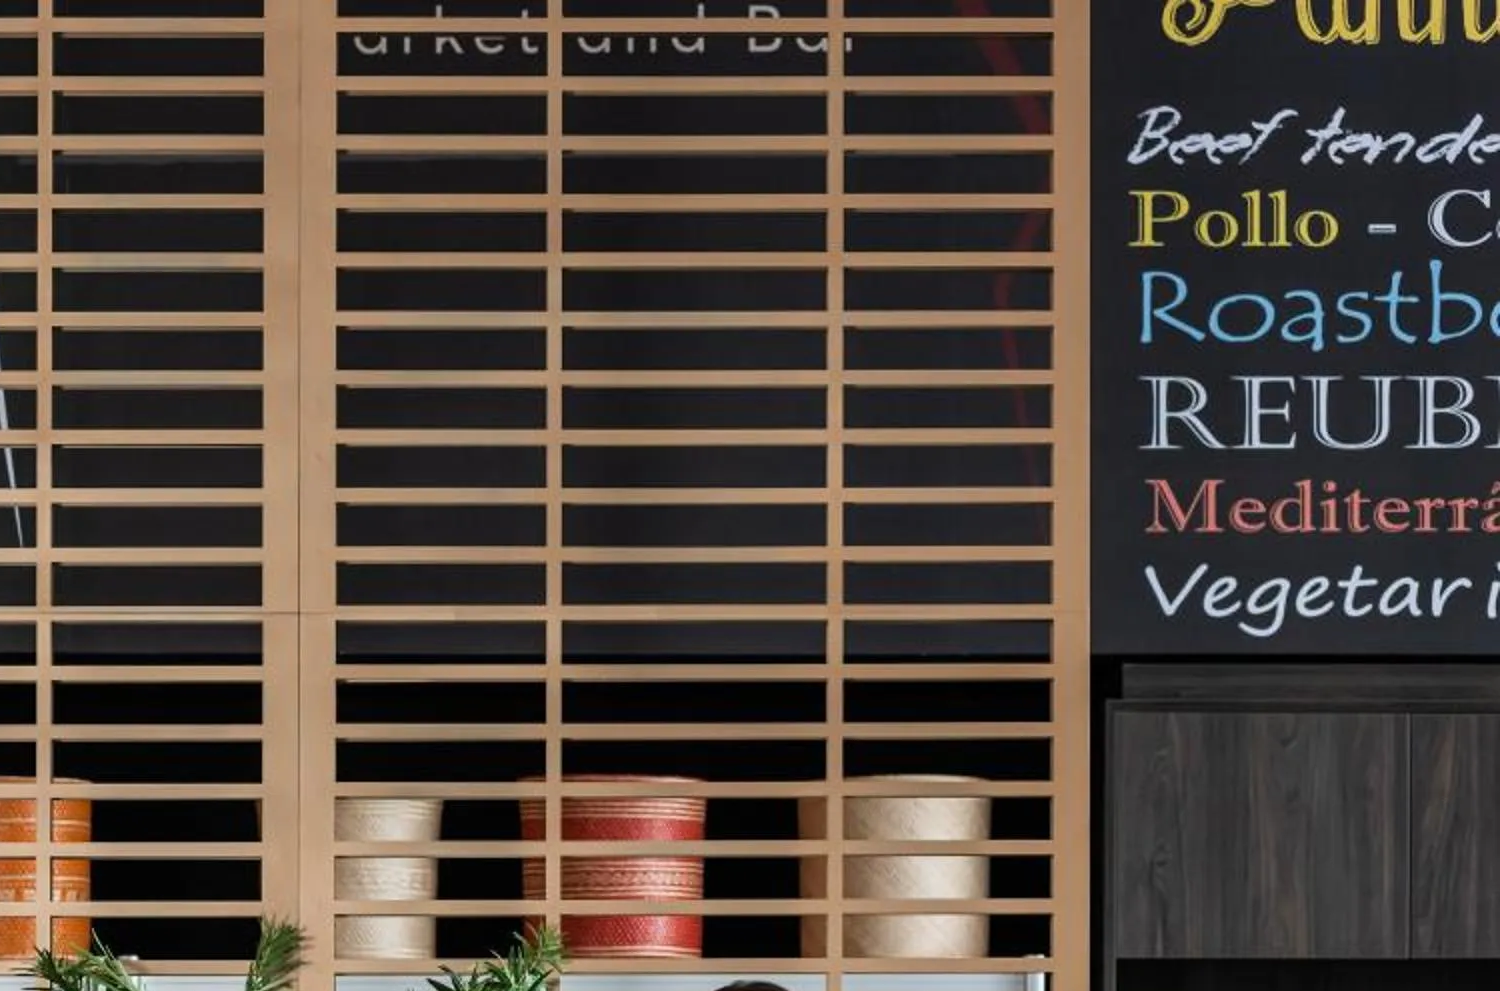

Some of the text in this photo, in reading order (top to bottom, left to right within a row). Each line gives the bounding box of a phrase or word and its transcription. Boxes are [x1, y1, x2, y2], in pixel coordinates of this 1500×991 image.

[1127, 106, 1298, 164] Beef
[1128, 189, 1339, 247] Pollo
[1427, 189, 1500, 247] C
[1140, 259, 1500, 352] Roastb
[1139, 376, 1500, 449] REUB
